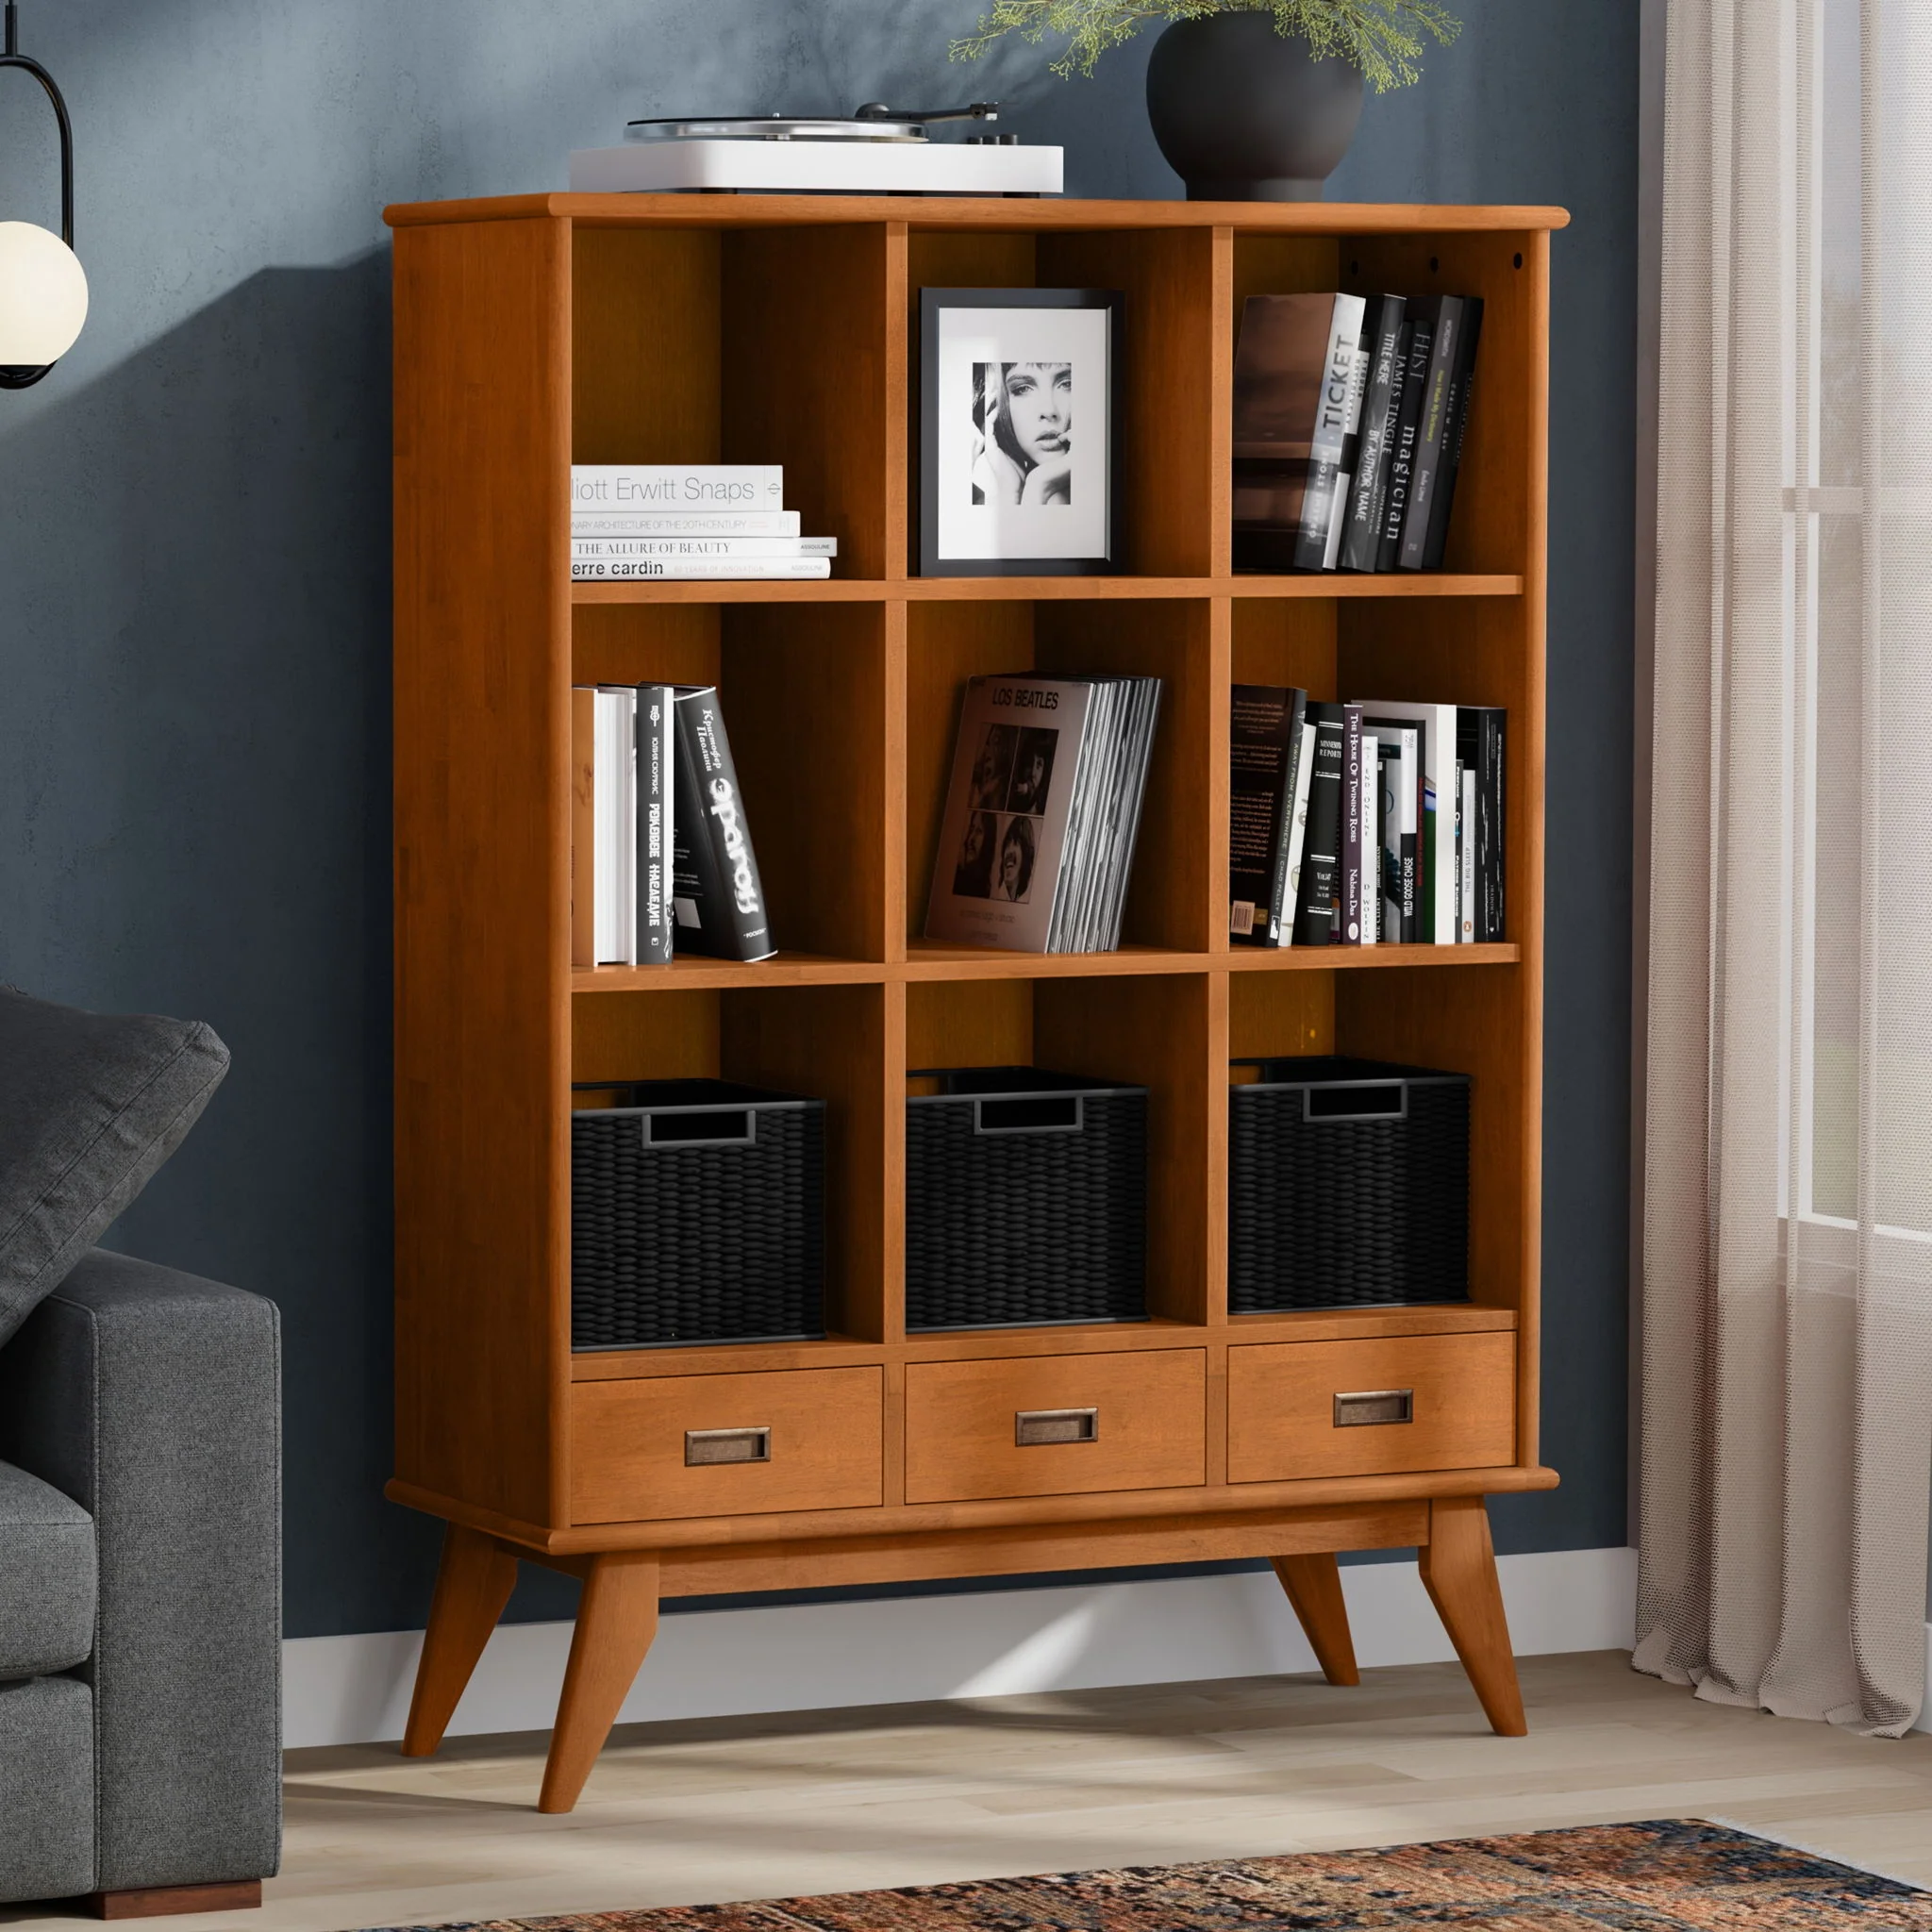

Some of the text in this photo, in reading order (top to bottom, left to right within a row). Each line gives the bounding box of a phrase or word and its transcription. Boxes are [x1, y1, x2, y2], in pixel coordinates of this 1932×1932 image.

[1323, 335, 1355, 428] TICKET
[1377, 333, 1395, 385] TITLE HERE
[1382, 356, 1407, 454] JAMES TINGLE
[1387, 332, 1430, 540] FEIST magician
[571, 476, 755, 504] liott Erwitt Snaps
[1317, 450, 1328, 486] STONE
[1355, 430, 1379, 521] BY AUTHOR NAME
[576, 541, 731, 555] THE ALLURE OF BEAUTY
[593, 519, 653, 530] ARCHITECTURE
[653, 519, 664, 530] OF
[665, 519, 681, 530] THE
[682, 519, 706, 530] 20TH
[707, 519, 746, 530] CENTURY
[571, 563, 606, 575] erre
[611, 561, 663, 575] cardin
[992, 688, 1059, 710] LOS BEATLES
[697, 725, 711, 772] Паолини
[702, 708, 722, 769] Кристофер
[1291, 742, 1300, 764] AWAY
[1282, 794, 1292, 850] EVERYWHERE
[1349, 713, 1358, 916] THE HOUSE OF TWINING ROSES Nabina Das
[647, 803, 660, 926] РОКОВОЕ НАСЛЕДИЕ
[1404, 858, 1413, 917] WILD GOOSE CHASE
[1274, 885, 1282, 911] PELLEY
